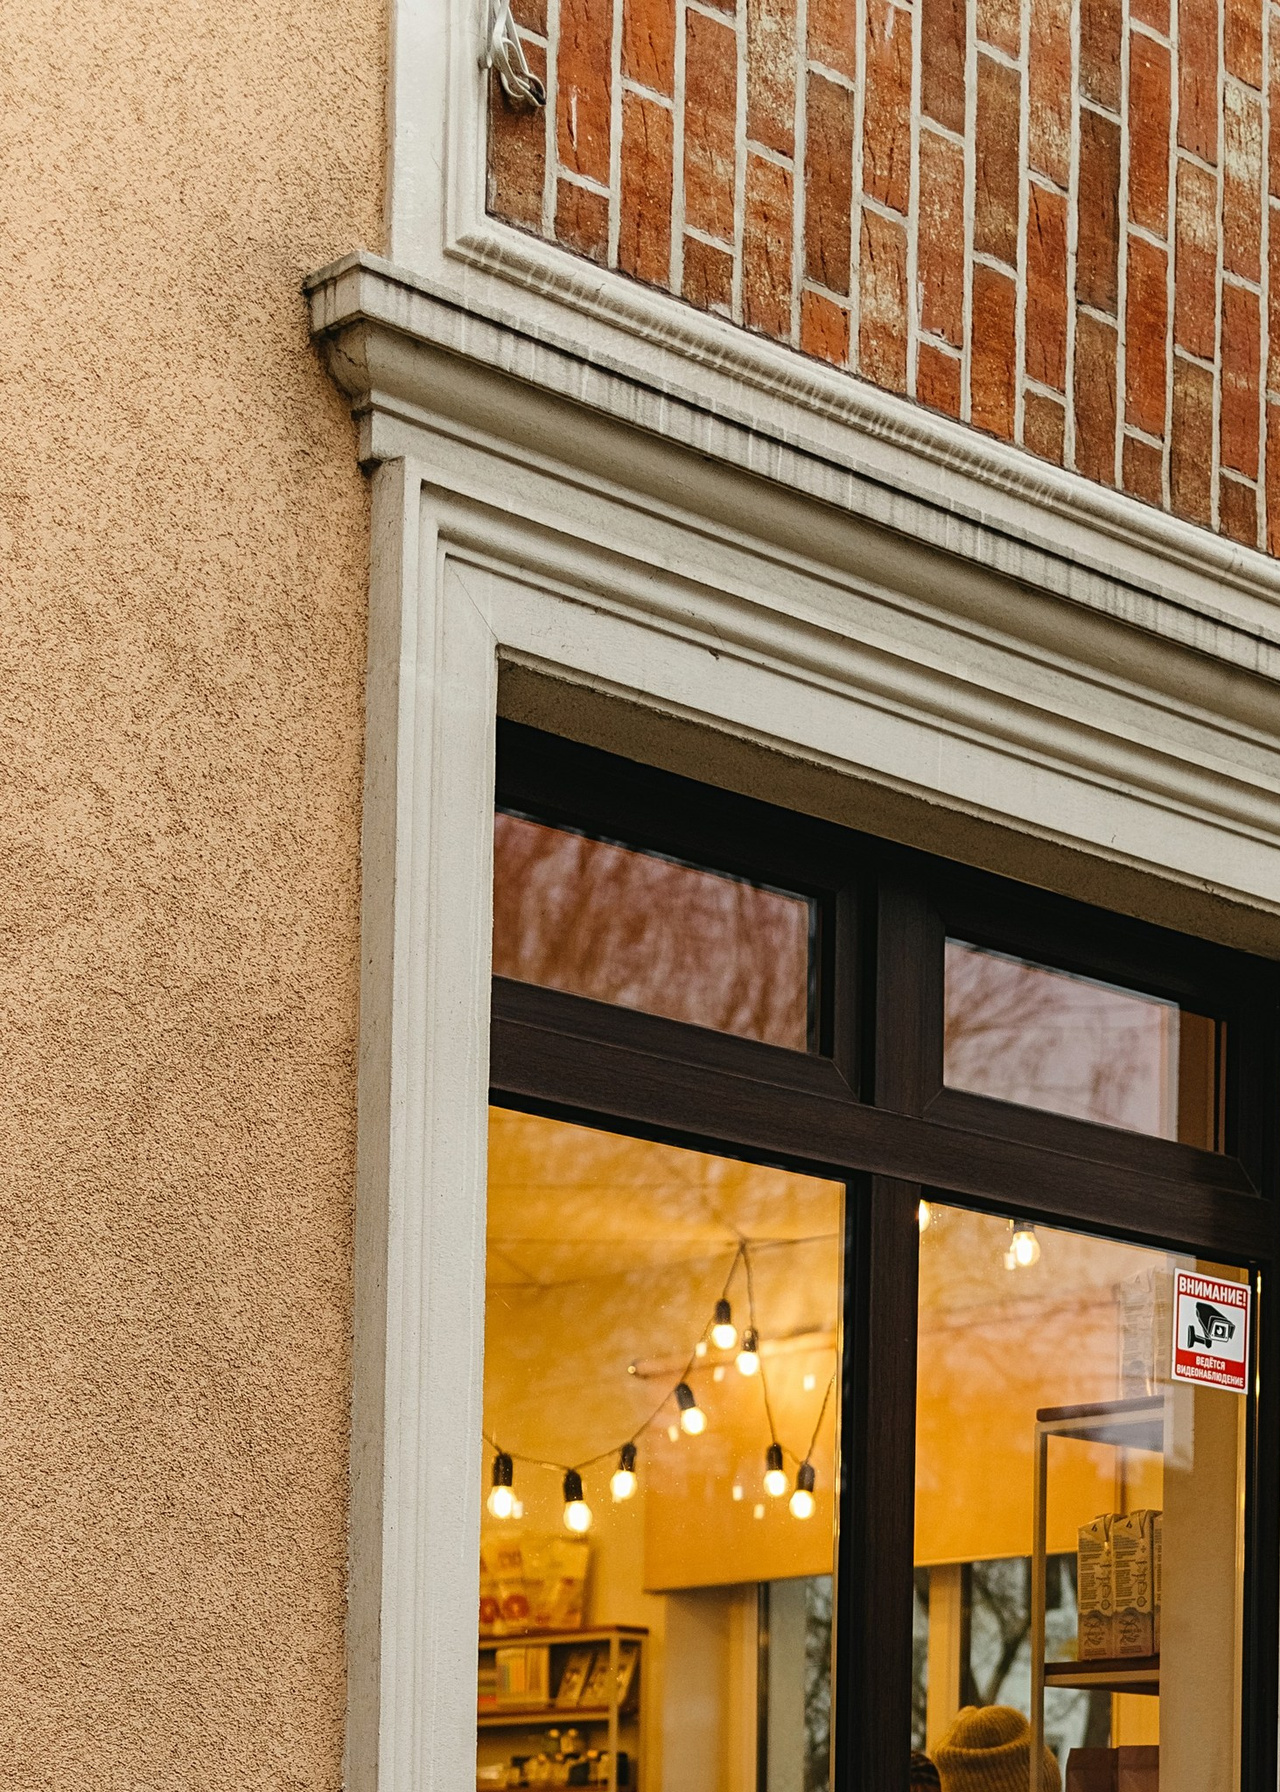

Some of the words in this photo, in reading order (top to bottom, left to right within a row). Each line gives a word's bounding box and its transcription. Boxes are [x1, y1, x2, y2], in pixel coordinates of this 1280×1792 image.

[1179, 1276, 1247, 1307] ВНИМАНИЕ!
[1176, 1363, 1245, 1387] ВИДЕОНАБЛЮДЕНИЕ
[1195, 1355, 1226, 1371] ВЕДЁТСЯ
